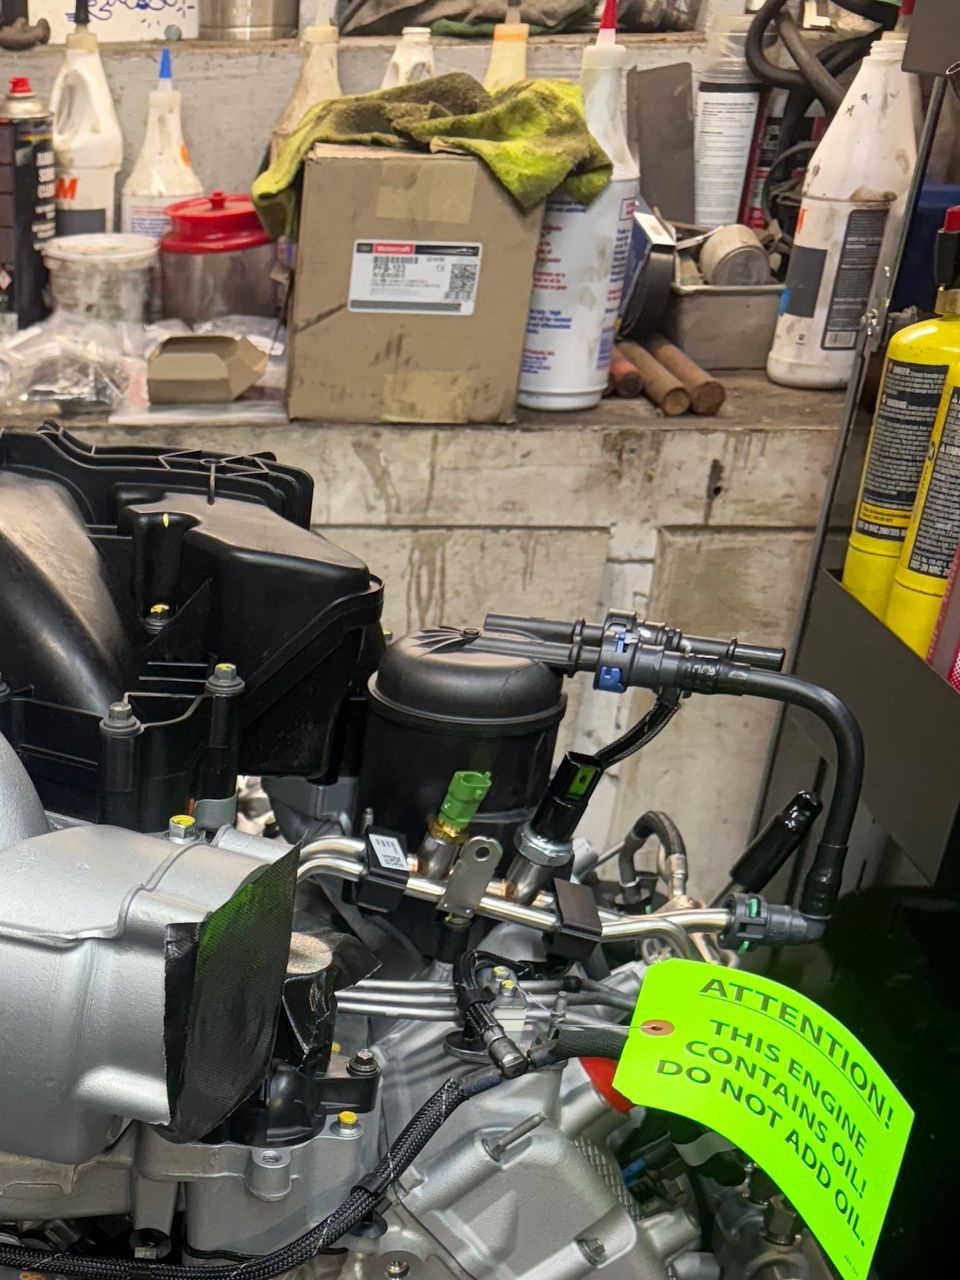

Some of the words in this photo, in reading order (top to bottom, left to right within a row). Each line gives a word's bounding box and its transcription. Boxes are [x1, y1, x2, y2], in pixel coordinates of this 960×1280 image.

[56, 177, 78, 201] M
[685, 1040, 828, 1144] CONTAINS
[831, 1141, 868, 1200] OIL!
[699, 978, 894, 1130] ATTENTION!
[709, 1019, 781, 1064] THIS
[788, 1057, 868, 1158] ENGINE
[656, 1059, 712, 1085] DO
[720, 1077, 784, 1129] NOT
[784, 1126, 832, 1190] ADD
[834, 1190, 867, 1248] OIL.
